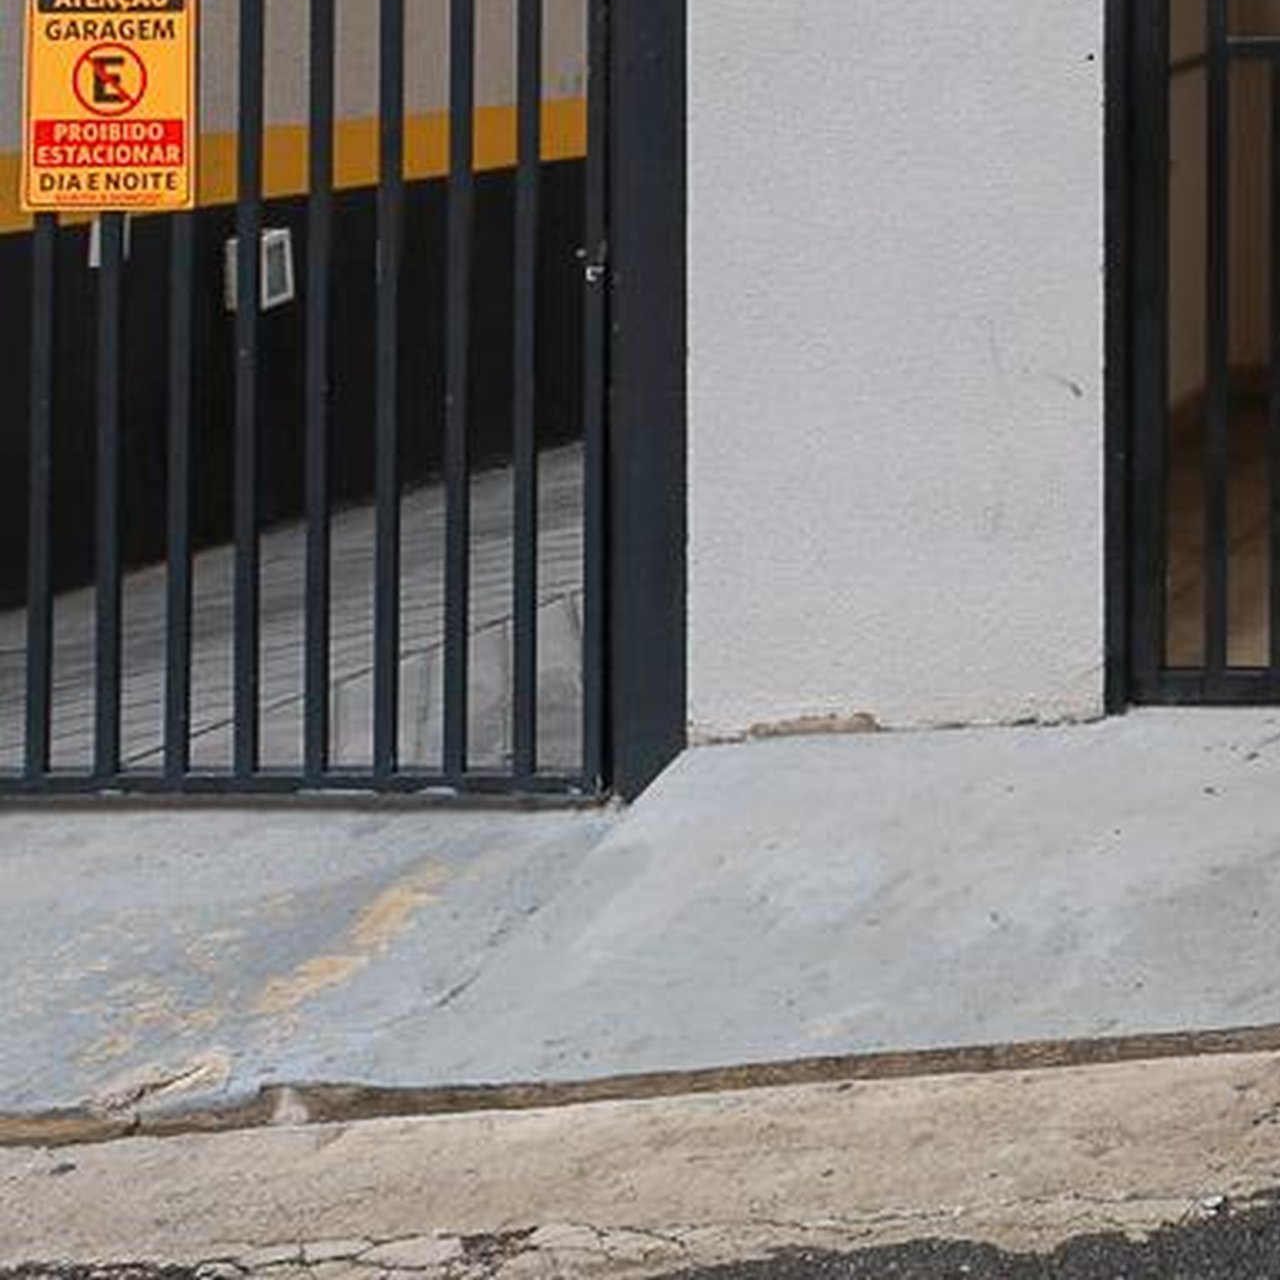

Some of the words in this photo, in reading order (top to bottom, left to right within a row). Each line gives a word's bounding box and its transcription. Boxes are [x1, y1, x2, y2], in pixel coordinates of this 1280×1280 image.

[44, 18, 176, 42] GARAGEM
[53, 122, 165, 142] PROIBIDO
[36, 144, 181, 165] ESTACIONAR
[39, 172, 81, 191] DIA
[87, 172, 100, 191] E
[104, 171, 178, 191] NOITE
